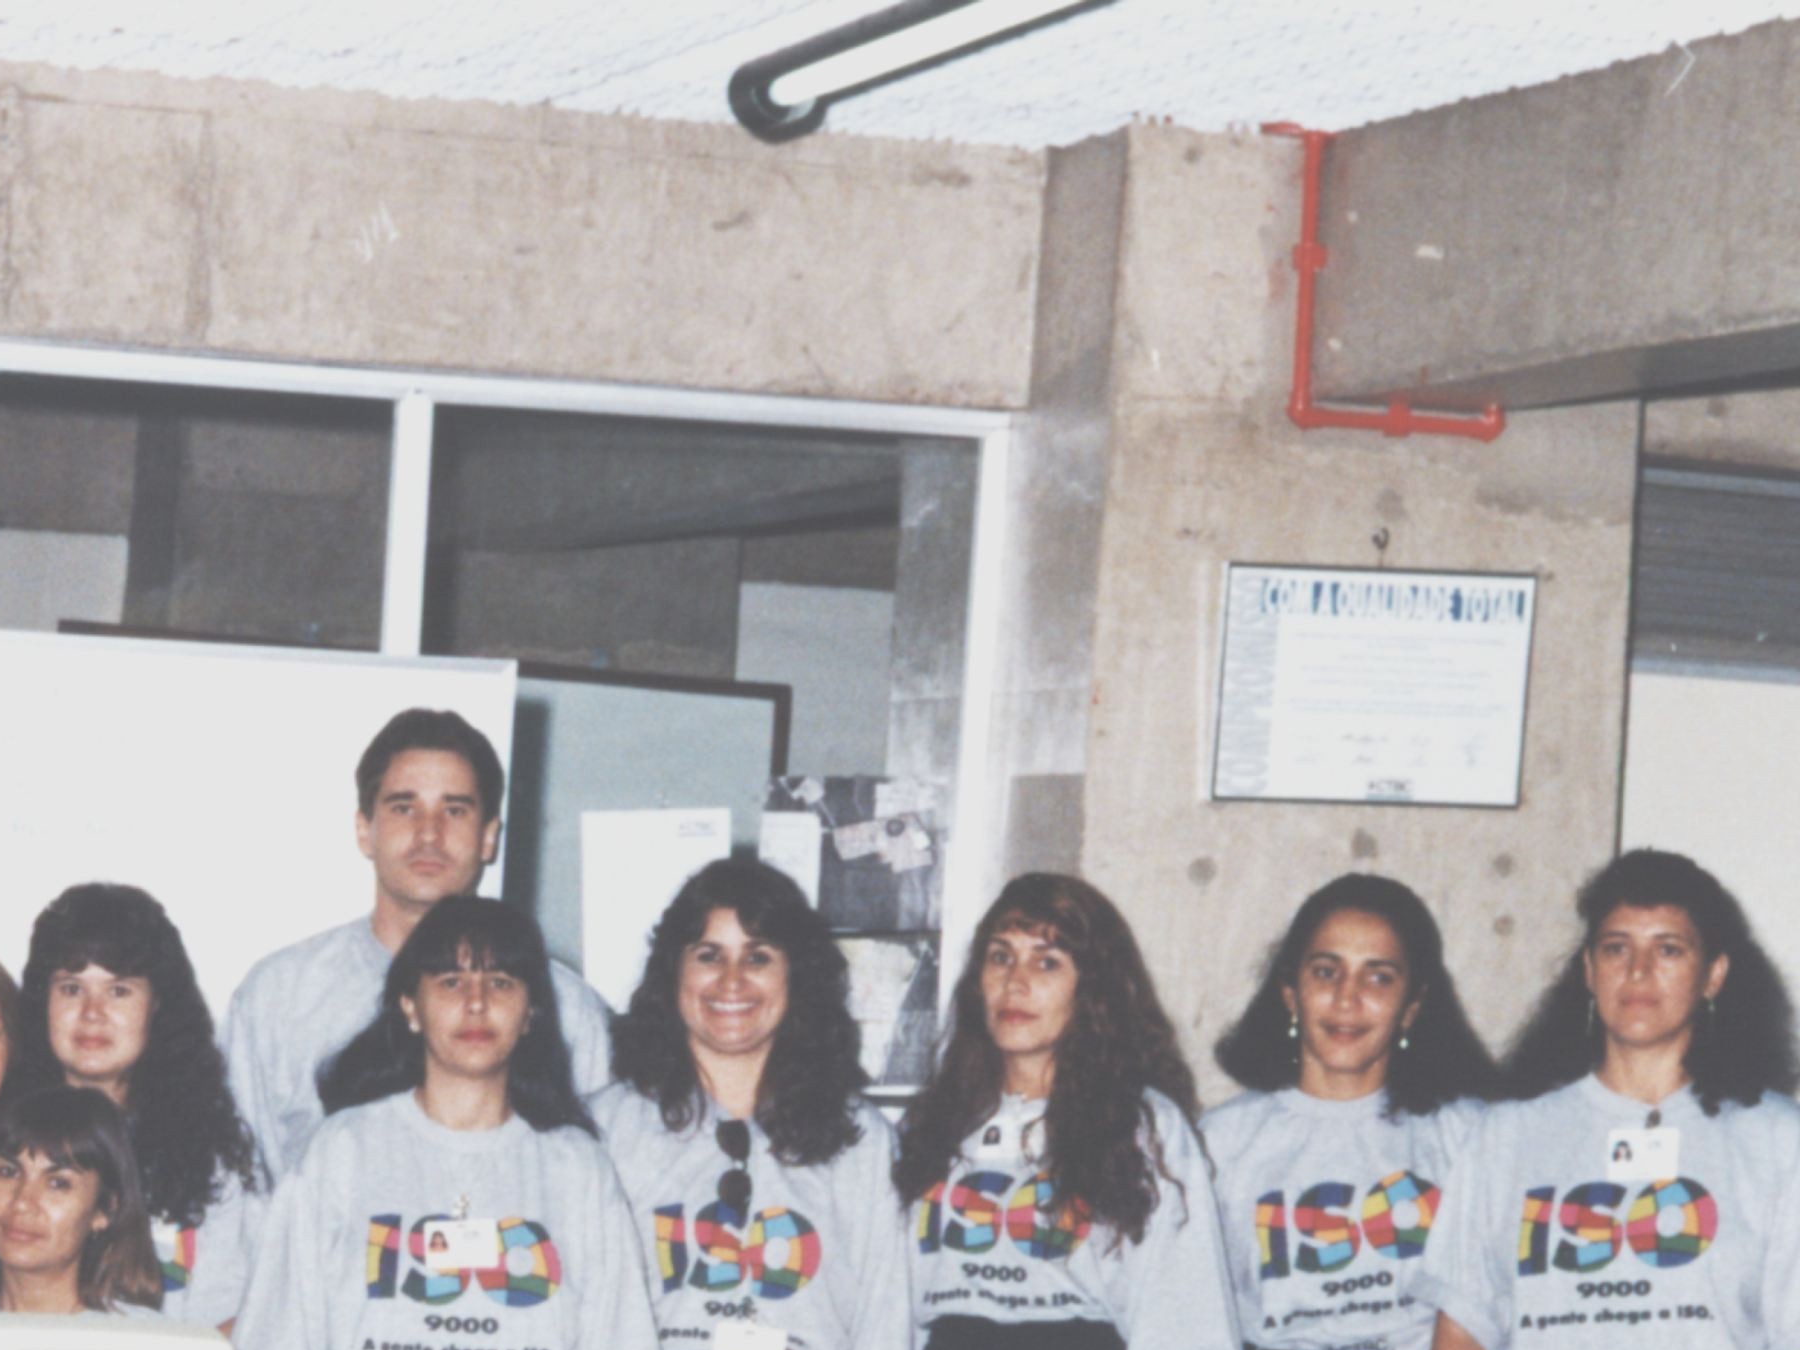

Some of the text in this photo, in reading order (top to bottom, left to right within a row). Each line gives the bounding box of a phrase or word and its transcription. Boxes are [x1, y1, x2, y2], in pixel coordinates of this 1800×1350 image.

[918, 1170, 1092, 1262] ISO
[1255, 1169, 1442, 1281] ISO
[1517, 1177, 1718, 1277] ISO
[366, 1213, 562, 1308] ISO
[653, 1202, 822, 1300] ISO
[961, 1263, 1028, 1283] 9000
[1321, 1271, 1393, 1297] 9000
[1575, 1280, 1653, 1298] 9000
[424, 1315, 499, 1334] 9000
[1263, 1314, 1277, 1330] A
[1519, 1314, 1532, 1329] A
[1537, 1311, 1587, 1330] gente
[1594, 1308, 1652, 1325] chega
[1658, 1308, 1670, 1320] a
